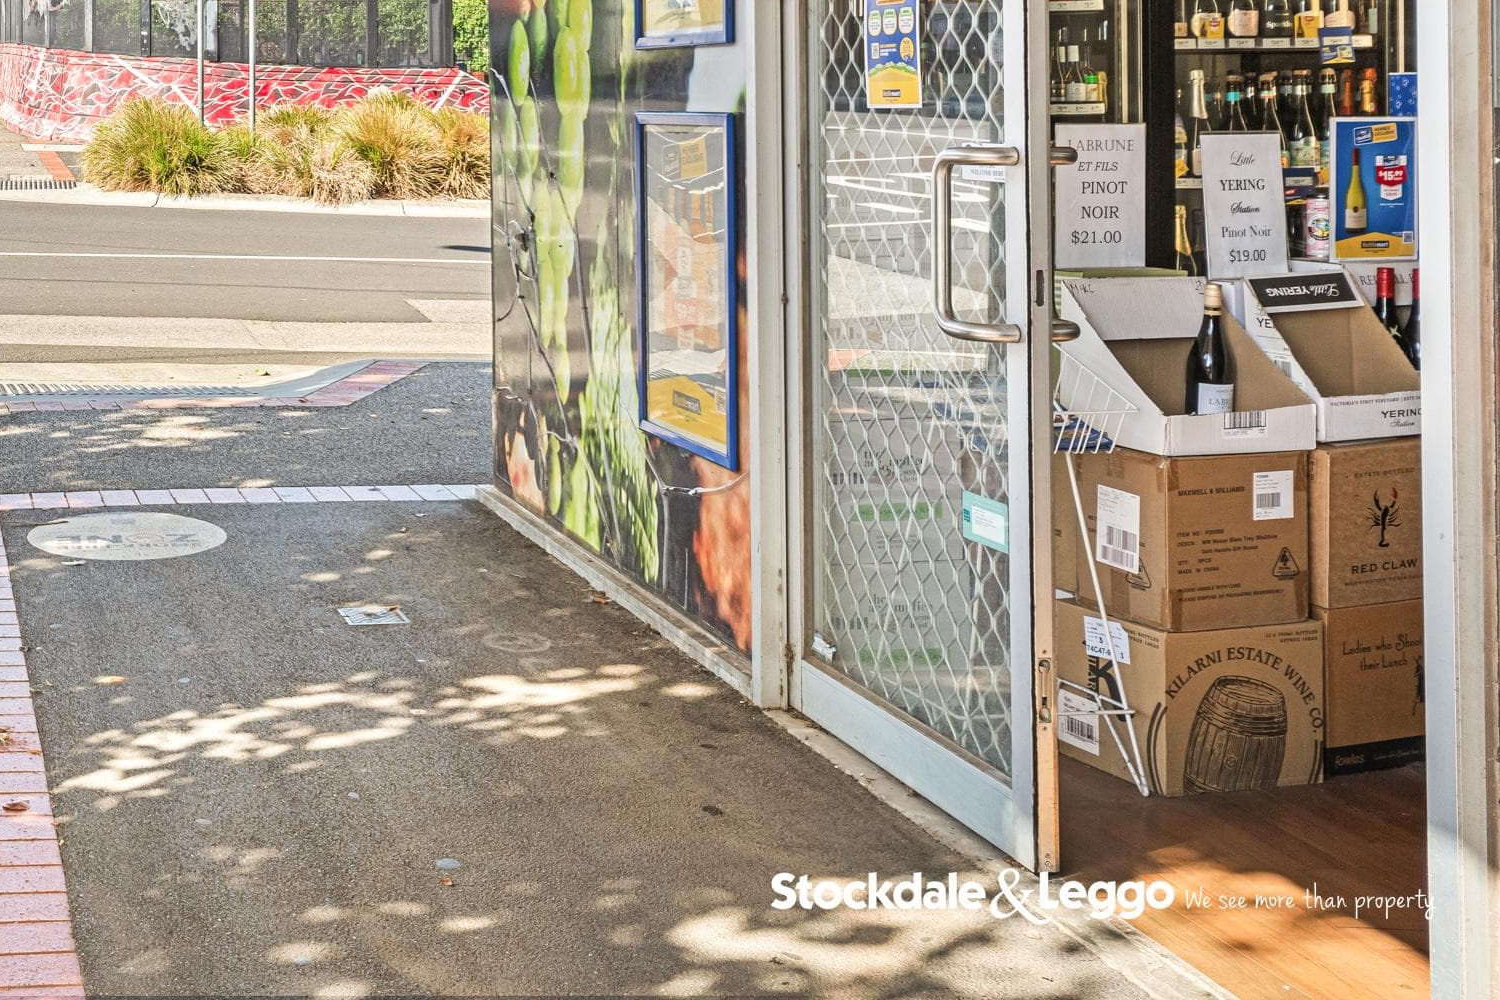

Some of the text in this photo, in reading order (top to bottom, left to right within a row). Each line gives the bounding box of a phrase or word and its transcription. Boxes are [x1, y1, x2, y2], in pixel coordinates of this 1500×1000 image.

[1230, 150, 1256, 167] Little
[1077, 161, 1118, 172] ET FILS
[1081, 181, 1128, 194] PINOT
[1220, 178, 1265, 191] YERING
[1081, 206, 1120, 219] NOIR
[1230, 201, 1260, 214] Station
[1071, 230, 1122, 245] $21.00
[1221, 225, 1272, 238] Pinot Noir
[1229, 249, 1266, 264] $19.00
[1266, 284, 1340, 297] Little YERING
[1351, 558, 1417, 575] RED CLAW
[1342, 640, 1372, 656] Ladies
[1375, 636, 1392, 651] who
[1360, 652, 1408, 672] their Lunch
[1165, 650, 1223, 700] KILARNI
[1227, 647, 1283, 670] ESTATE
[1283, 664, 1316, 705] WINE
